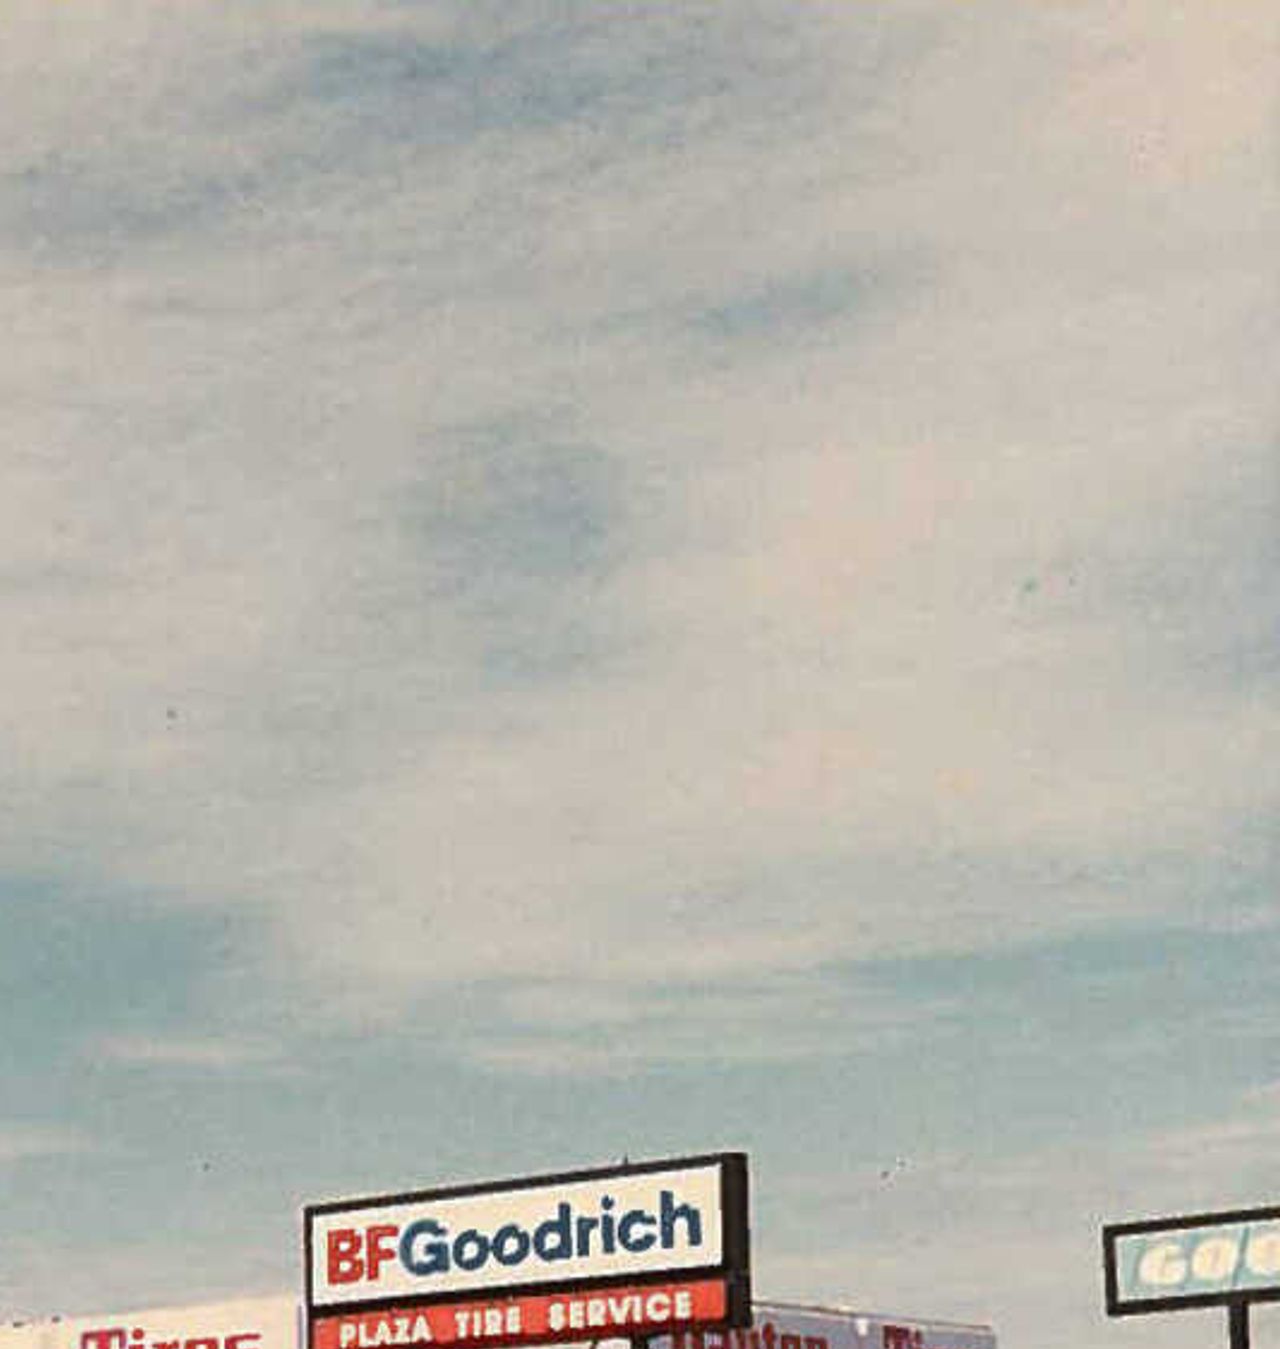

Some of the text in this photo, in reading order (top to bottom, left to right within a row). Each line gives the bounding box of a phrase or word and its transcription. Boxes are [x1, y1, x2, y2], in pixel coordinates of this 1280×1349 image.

[326, 1190, 702, 1285] BFGoodrich
[340, 1291, 694, 1349] PLAZA TIRE SERVICE
